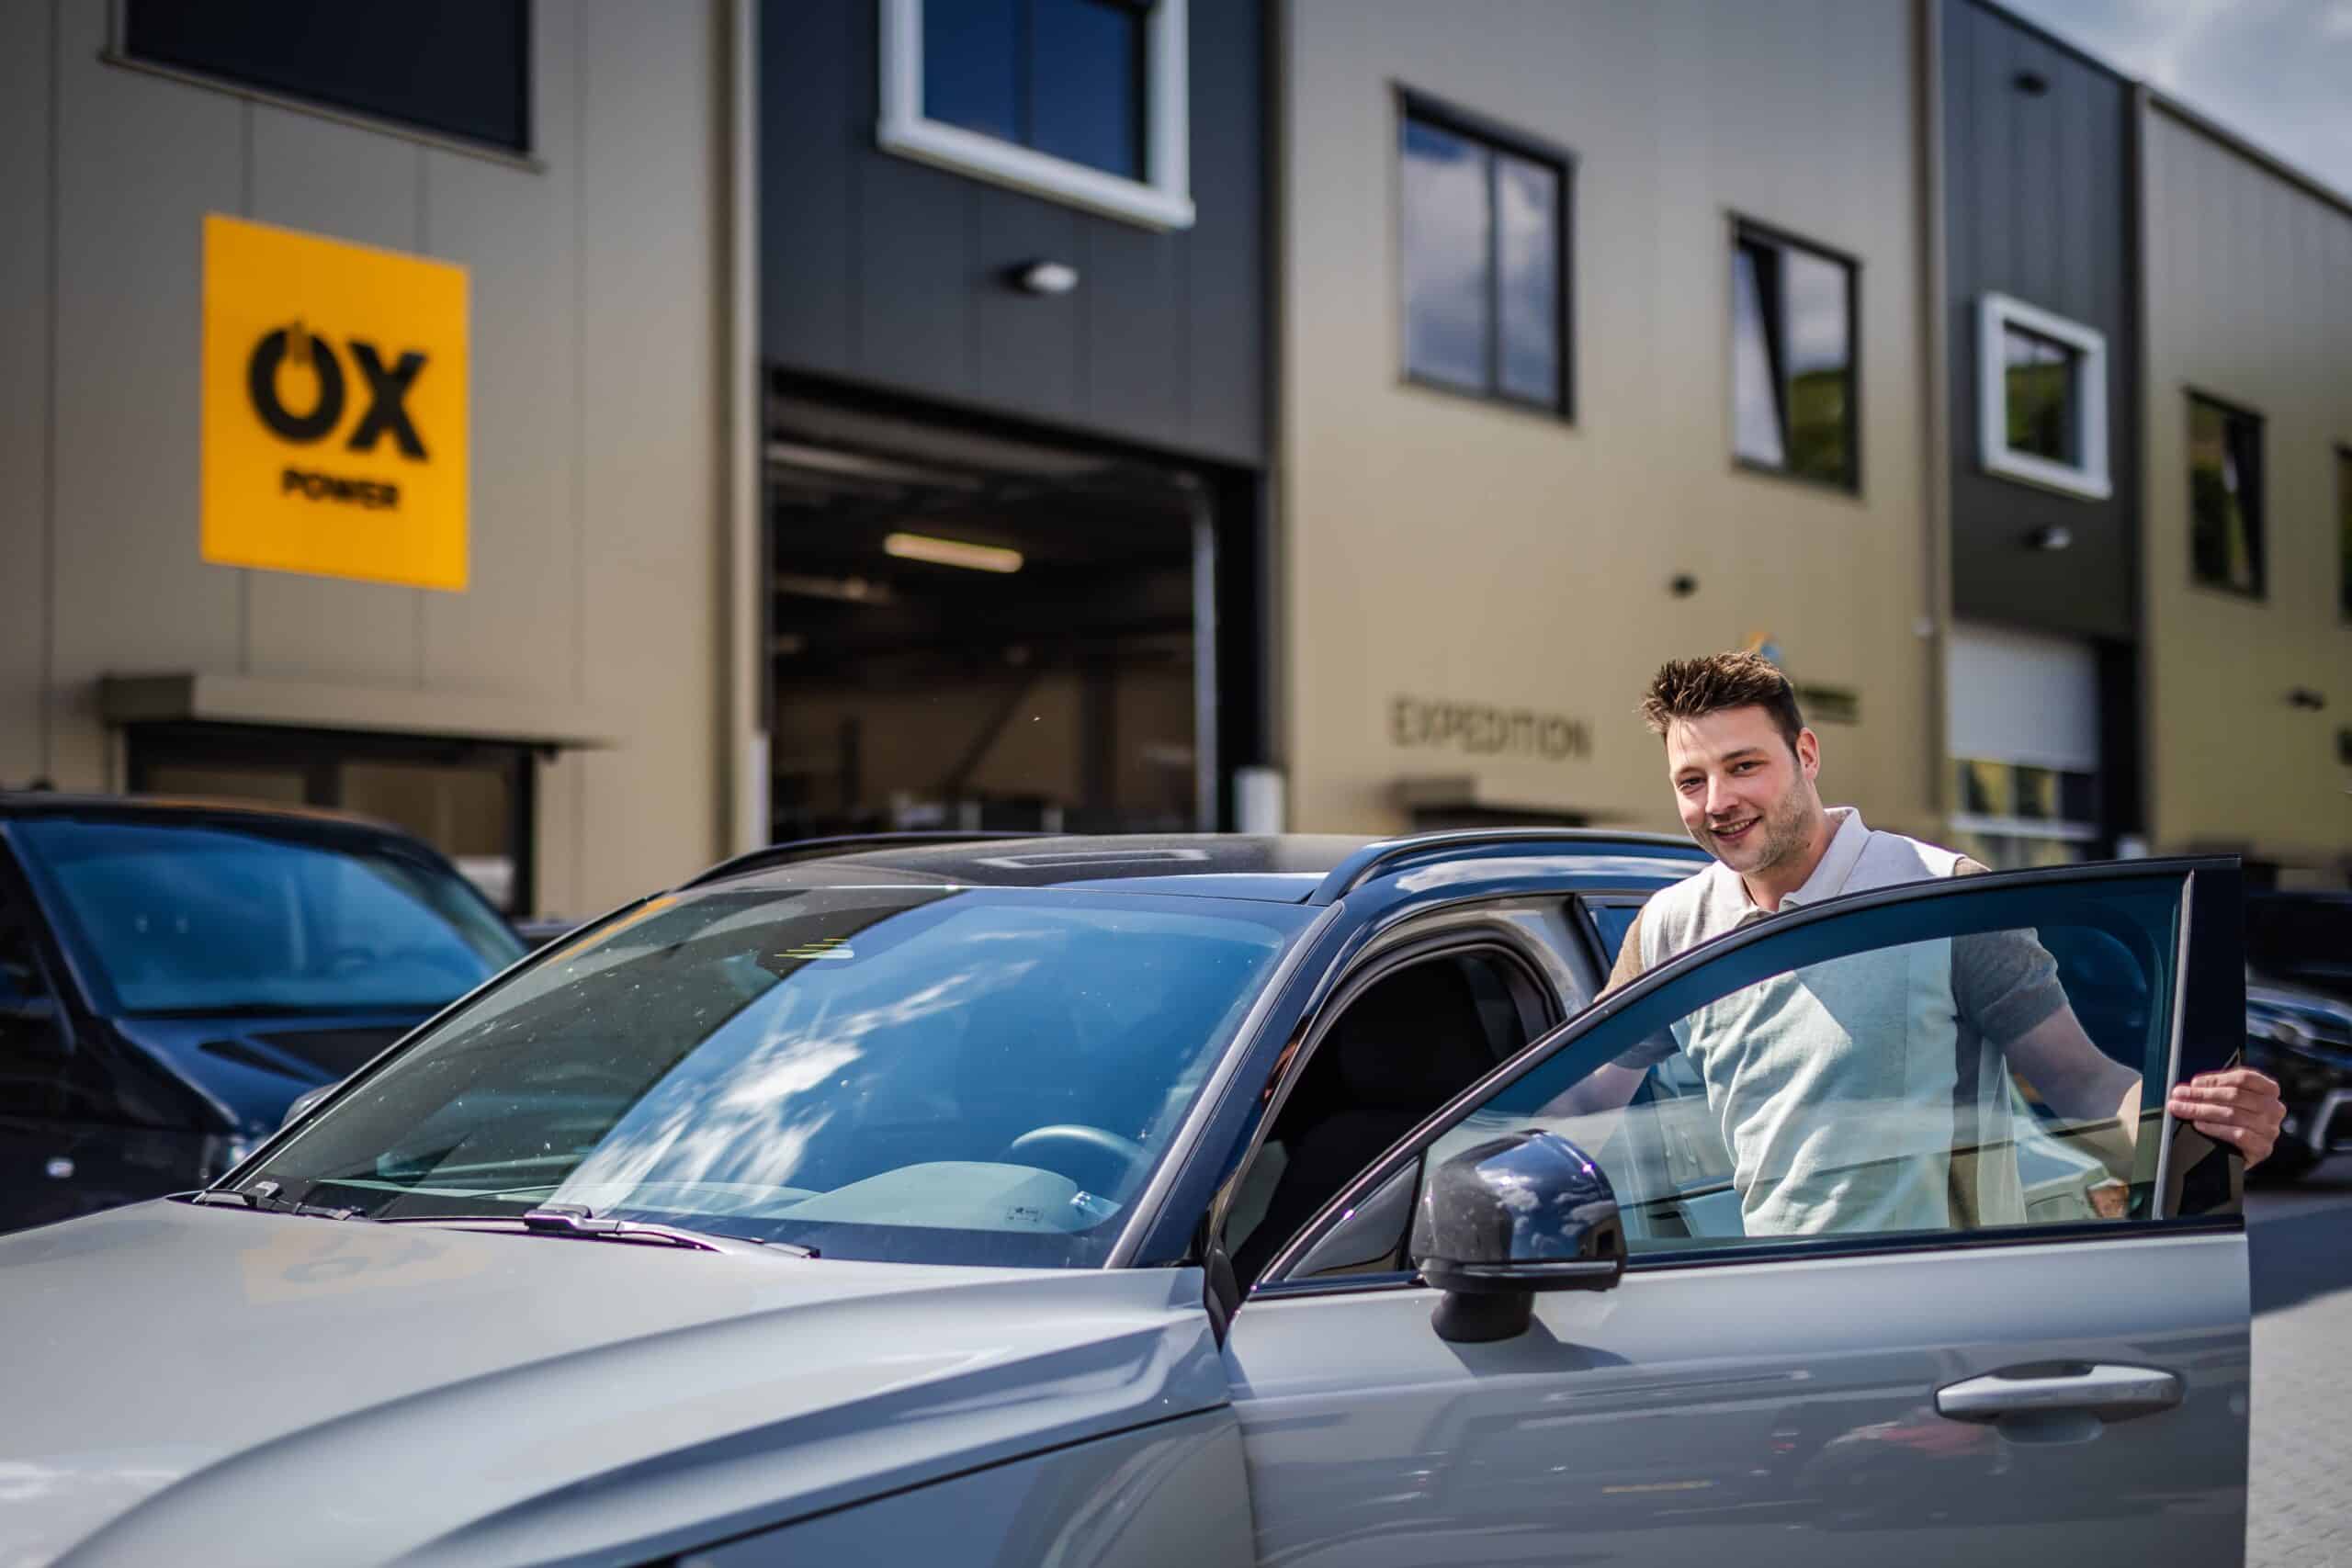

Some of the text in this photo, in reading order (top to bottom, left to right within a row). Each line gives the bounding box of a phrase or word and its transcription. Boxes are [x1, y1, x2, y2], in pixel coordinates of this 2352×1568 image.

[247, 321, 429, 462] OX
[282, 469, 399, 510] POWER
[1391, 696, 1591, 762] EXPEDITION
